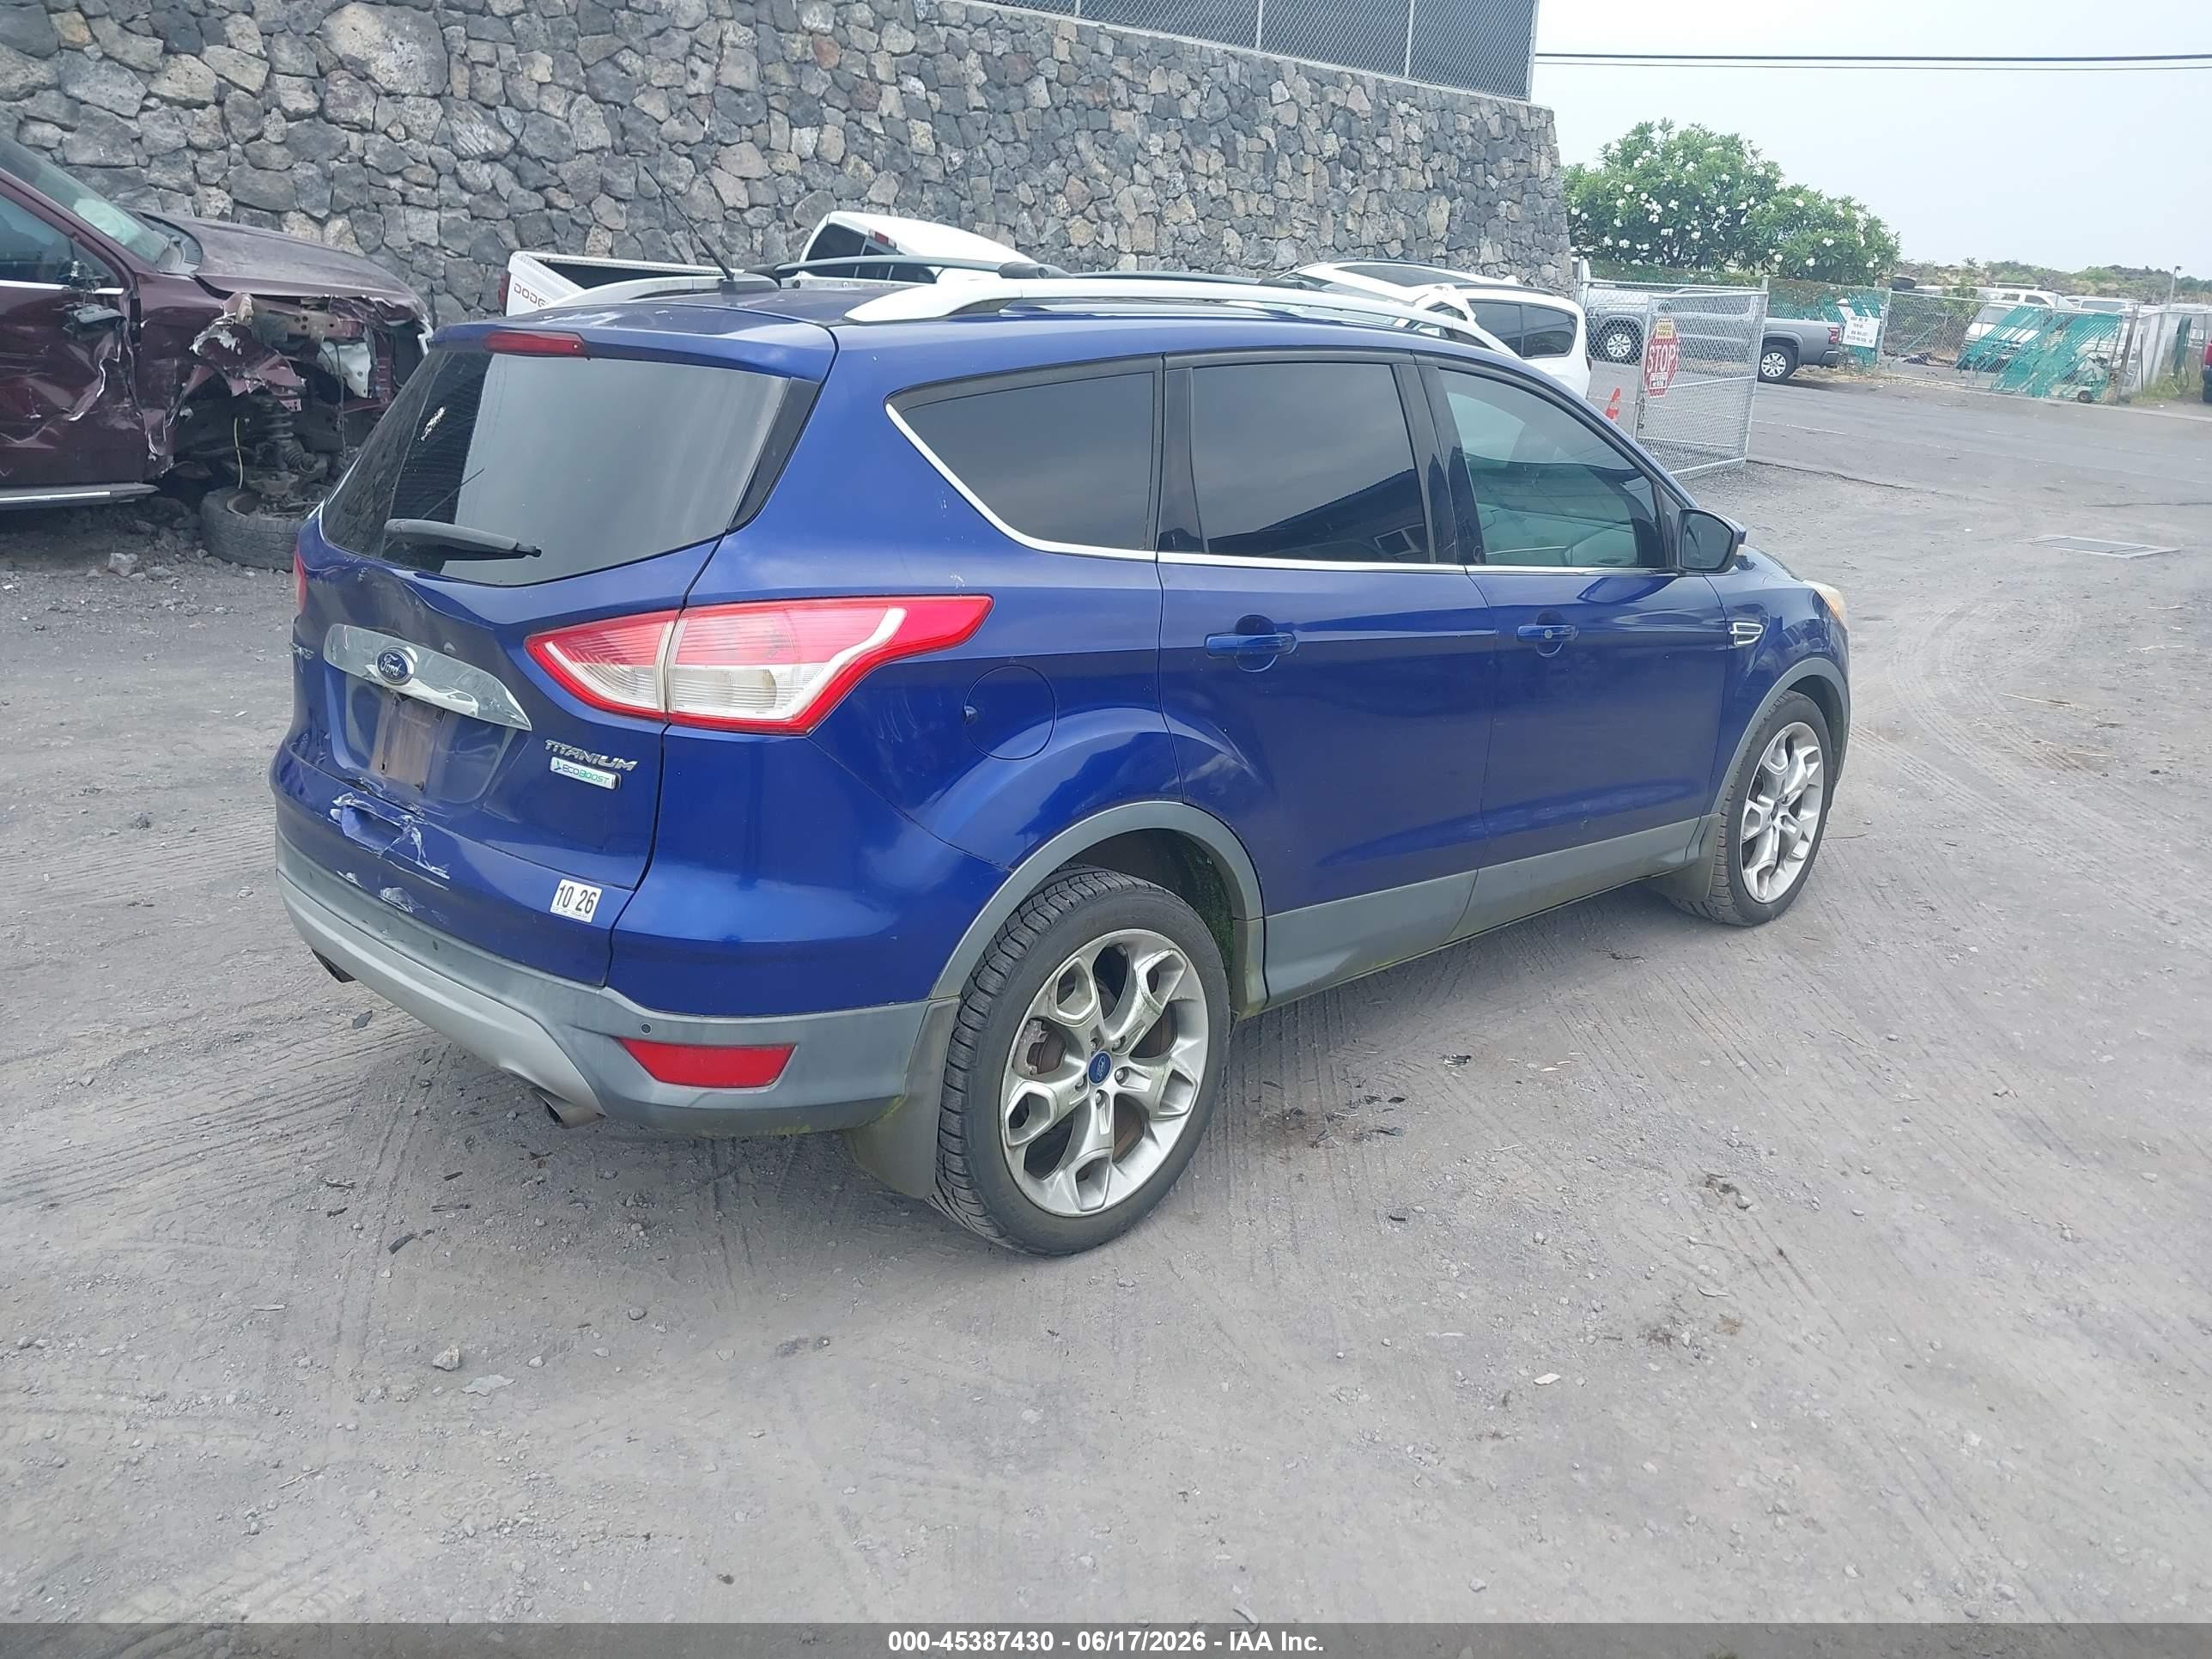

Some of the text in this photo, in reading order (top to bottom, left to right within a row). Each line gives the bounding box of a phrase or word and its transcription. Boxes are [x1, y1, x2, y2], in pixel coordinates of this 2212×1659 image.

[514, 283, 549, 307] DODG
[1647, 343, 1677, 374] STOP
[380, 653, 405, 677] Ford
[544, 738, 638, 771] TITANIUM
[562, 763, 611, 785] ECOBOOST
[556, 884, 574, 908] 10
[575, 889, 598, 915] 26
